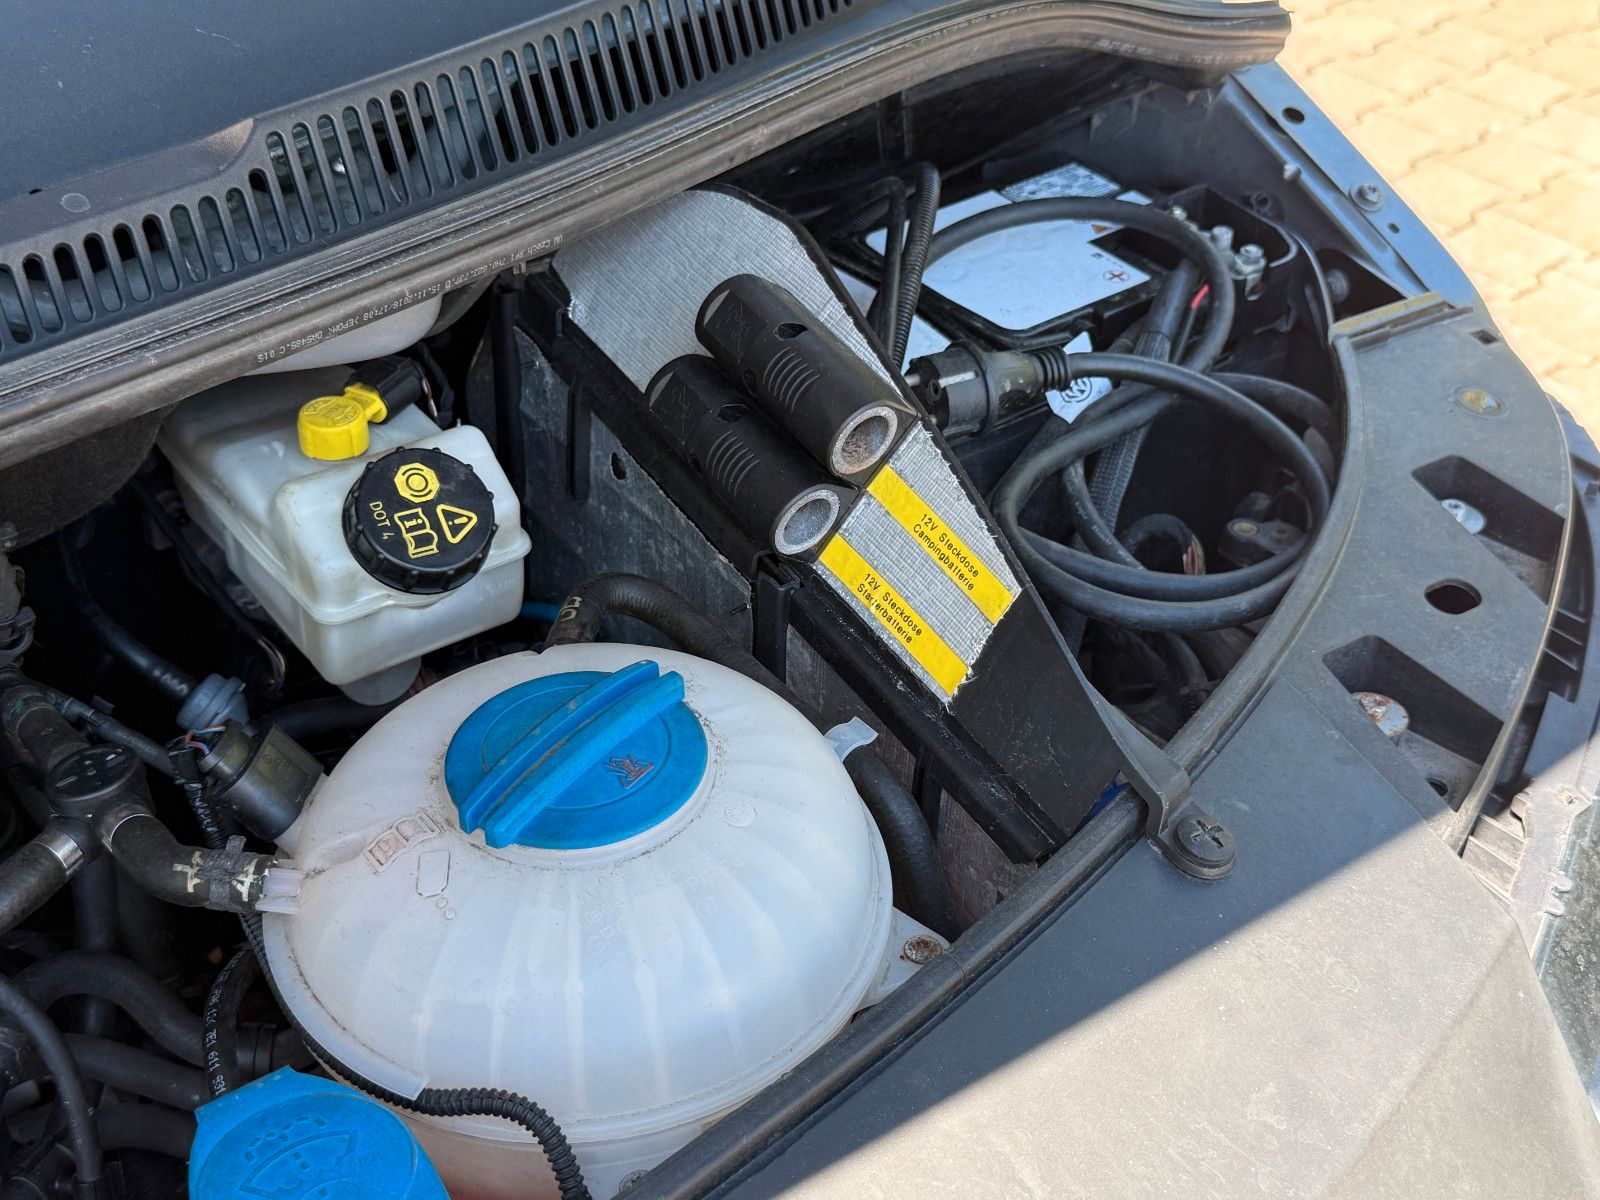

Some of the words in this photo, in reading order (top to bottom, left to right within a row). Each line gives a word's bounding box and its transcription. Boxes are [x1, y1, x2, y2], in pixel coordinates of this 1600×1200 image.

[369, 500, 391, 527] DOT
[382, 532, 394, 540] 4
[919, 512, 938, 532] 12V
[938, 532, 980, 578] Steckdose
[912, 523, 975, 591] Campingbatterie
[857, 583, 913, 644] Starterbatterie
[863, 573, 881, 591] 12V
[882, 591, 923, 637] Steckdose
